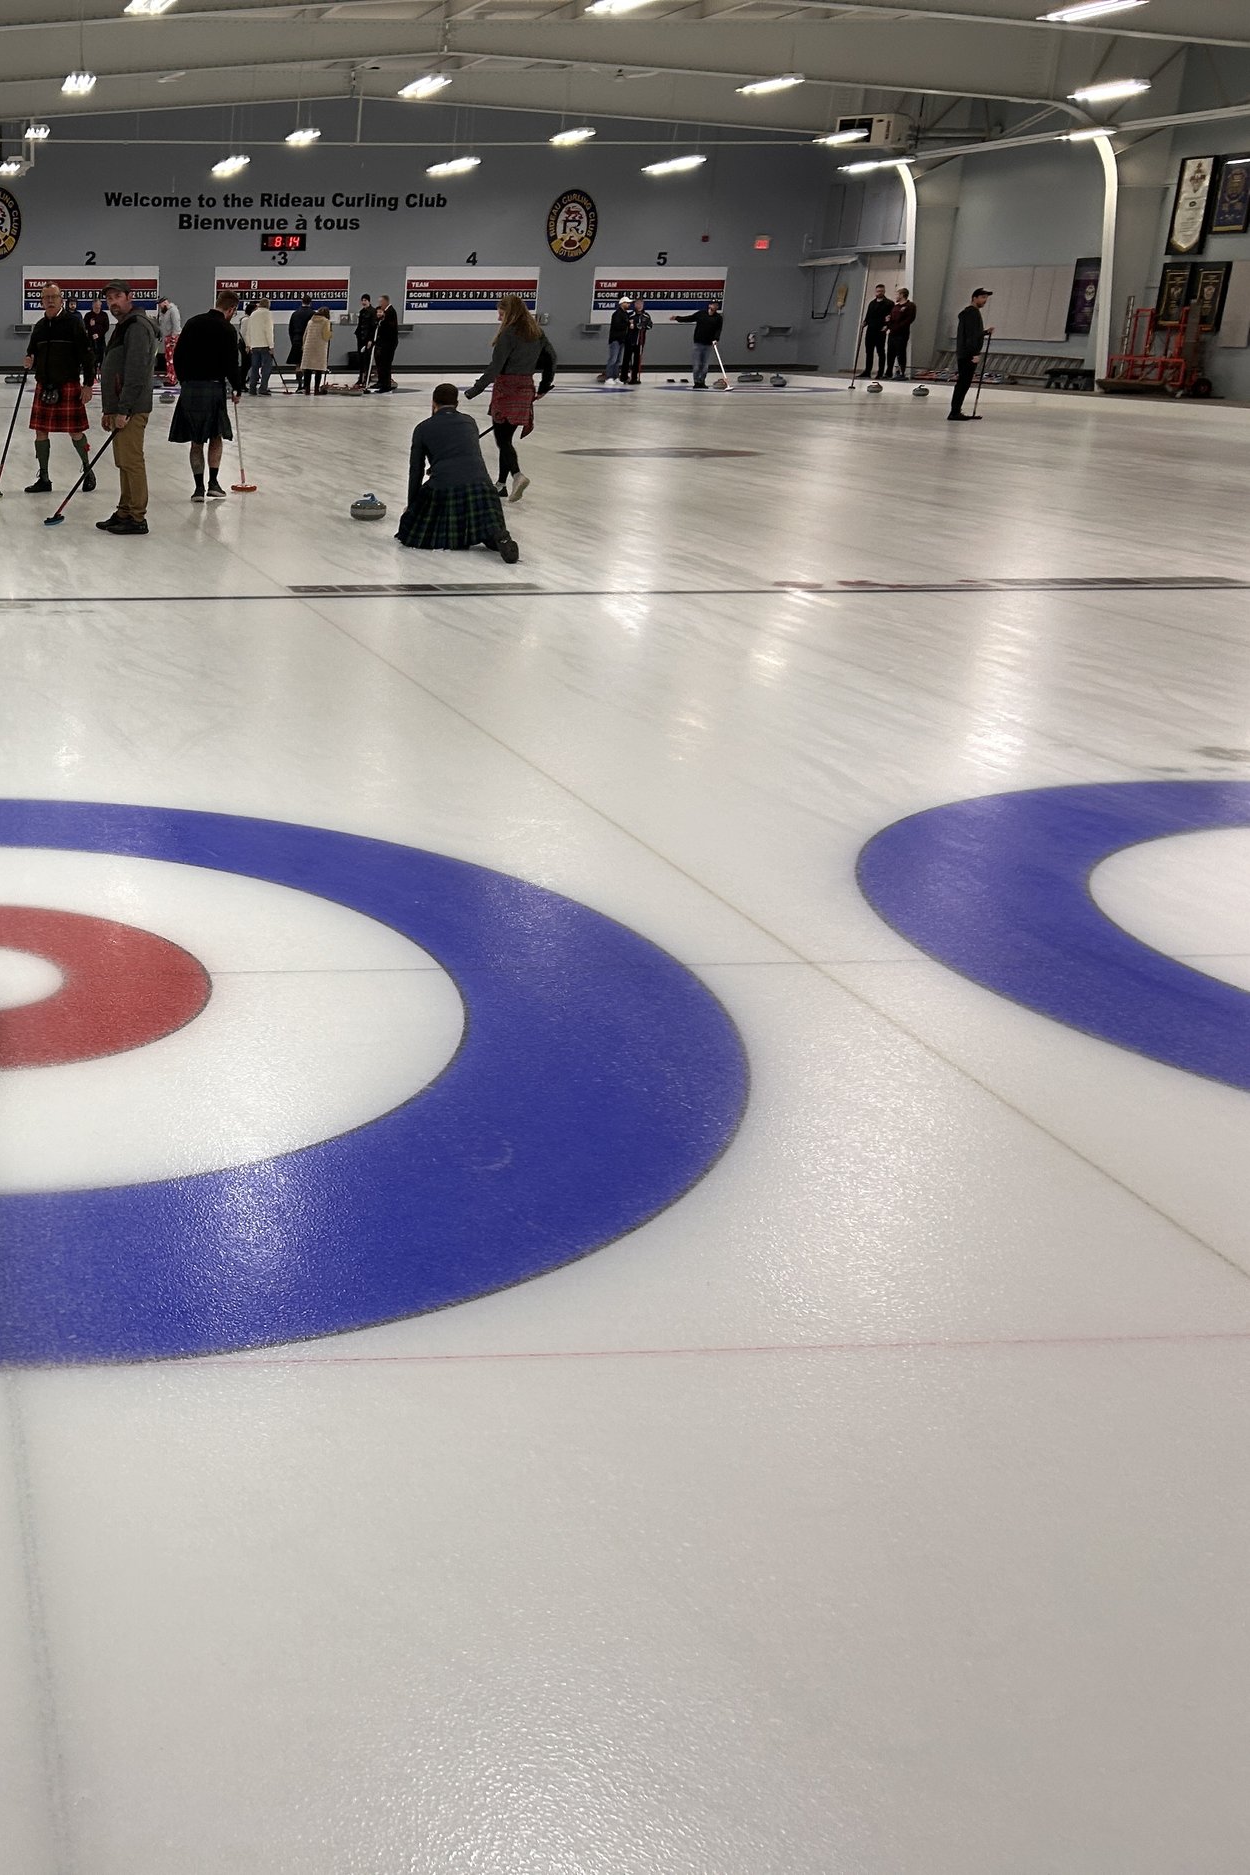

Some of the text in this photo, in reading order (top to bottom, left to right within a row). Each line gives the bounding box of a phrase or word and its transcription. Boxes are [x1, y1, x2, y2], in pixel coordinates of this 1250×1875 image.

[104, 192, 448, 211] Welcome to the Rideau Curling Club
[11, 210, 20, 236] CLUB
[178, 213, 361, 230] Bienvenue à tous
[85, 251, 96, 265] 2
[277, 251, 288, 266] 3
[466, 251, 478, 265] 4
[656, 251, 668, 266] 5
